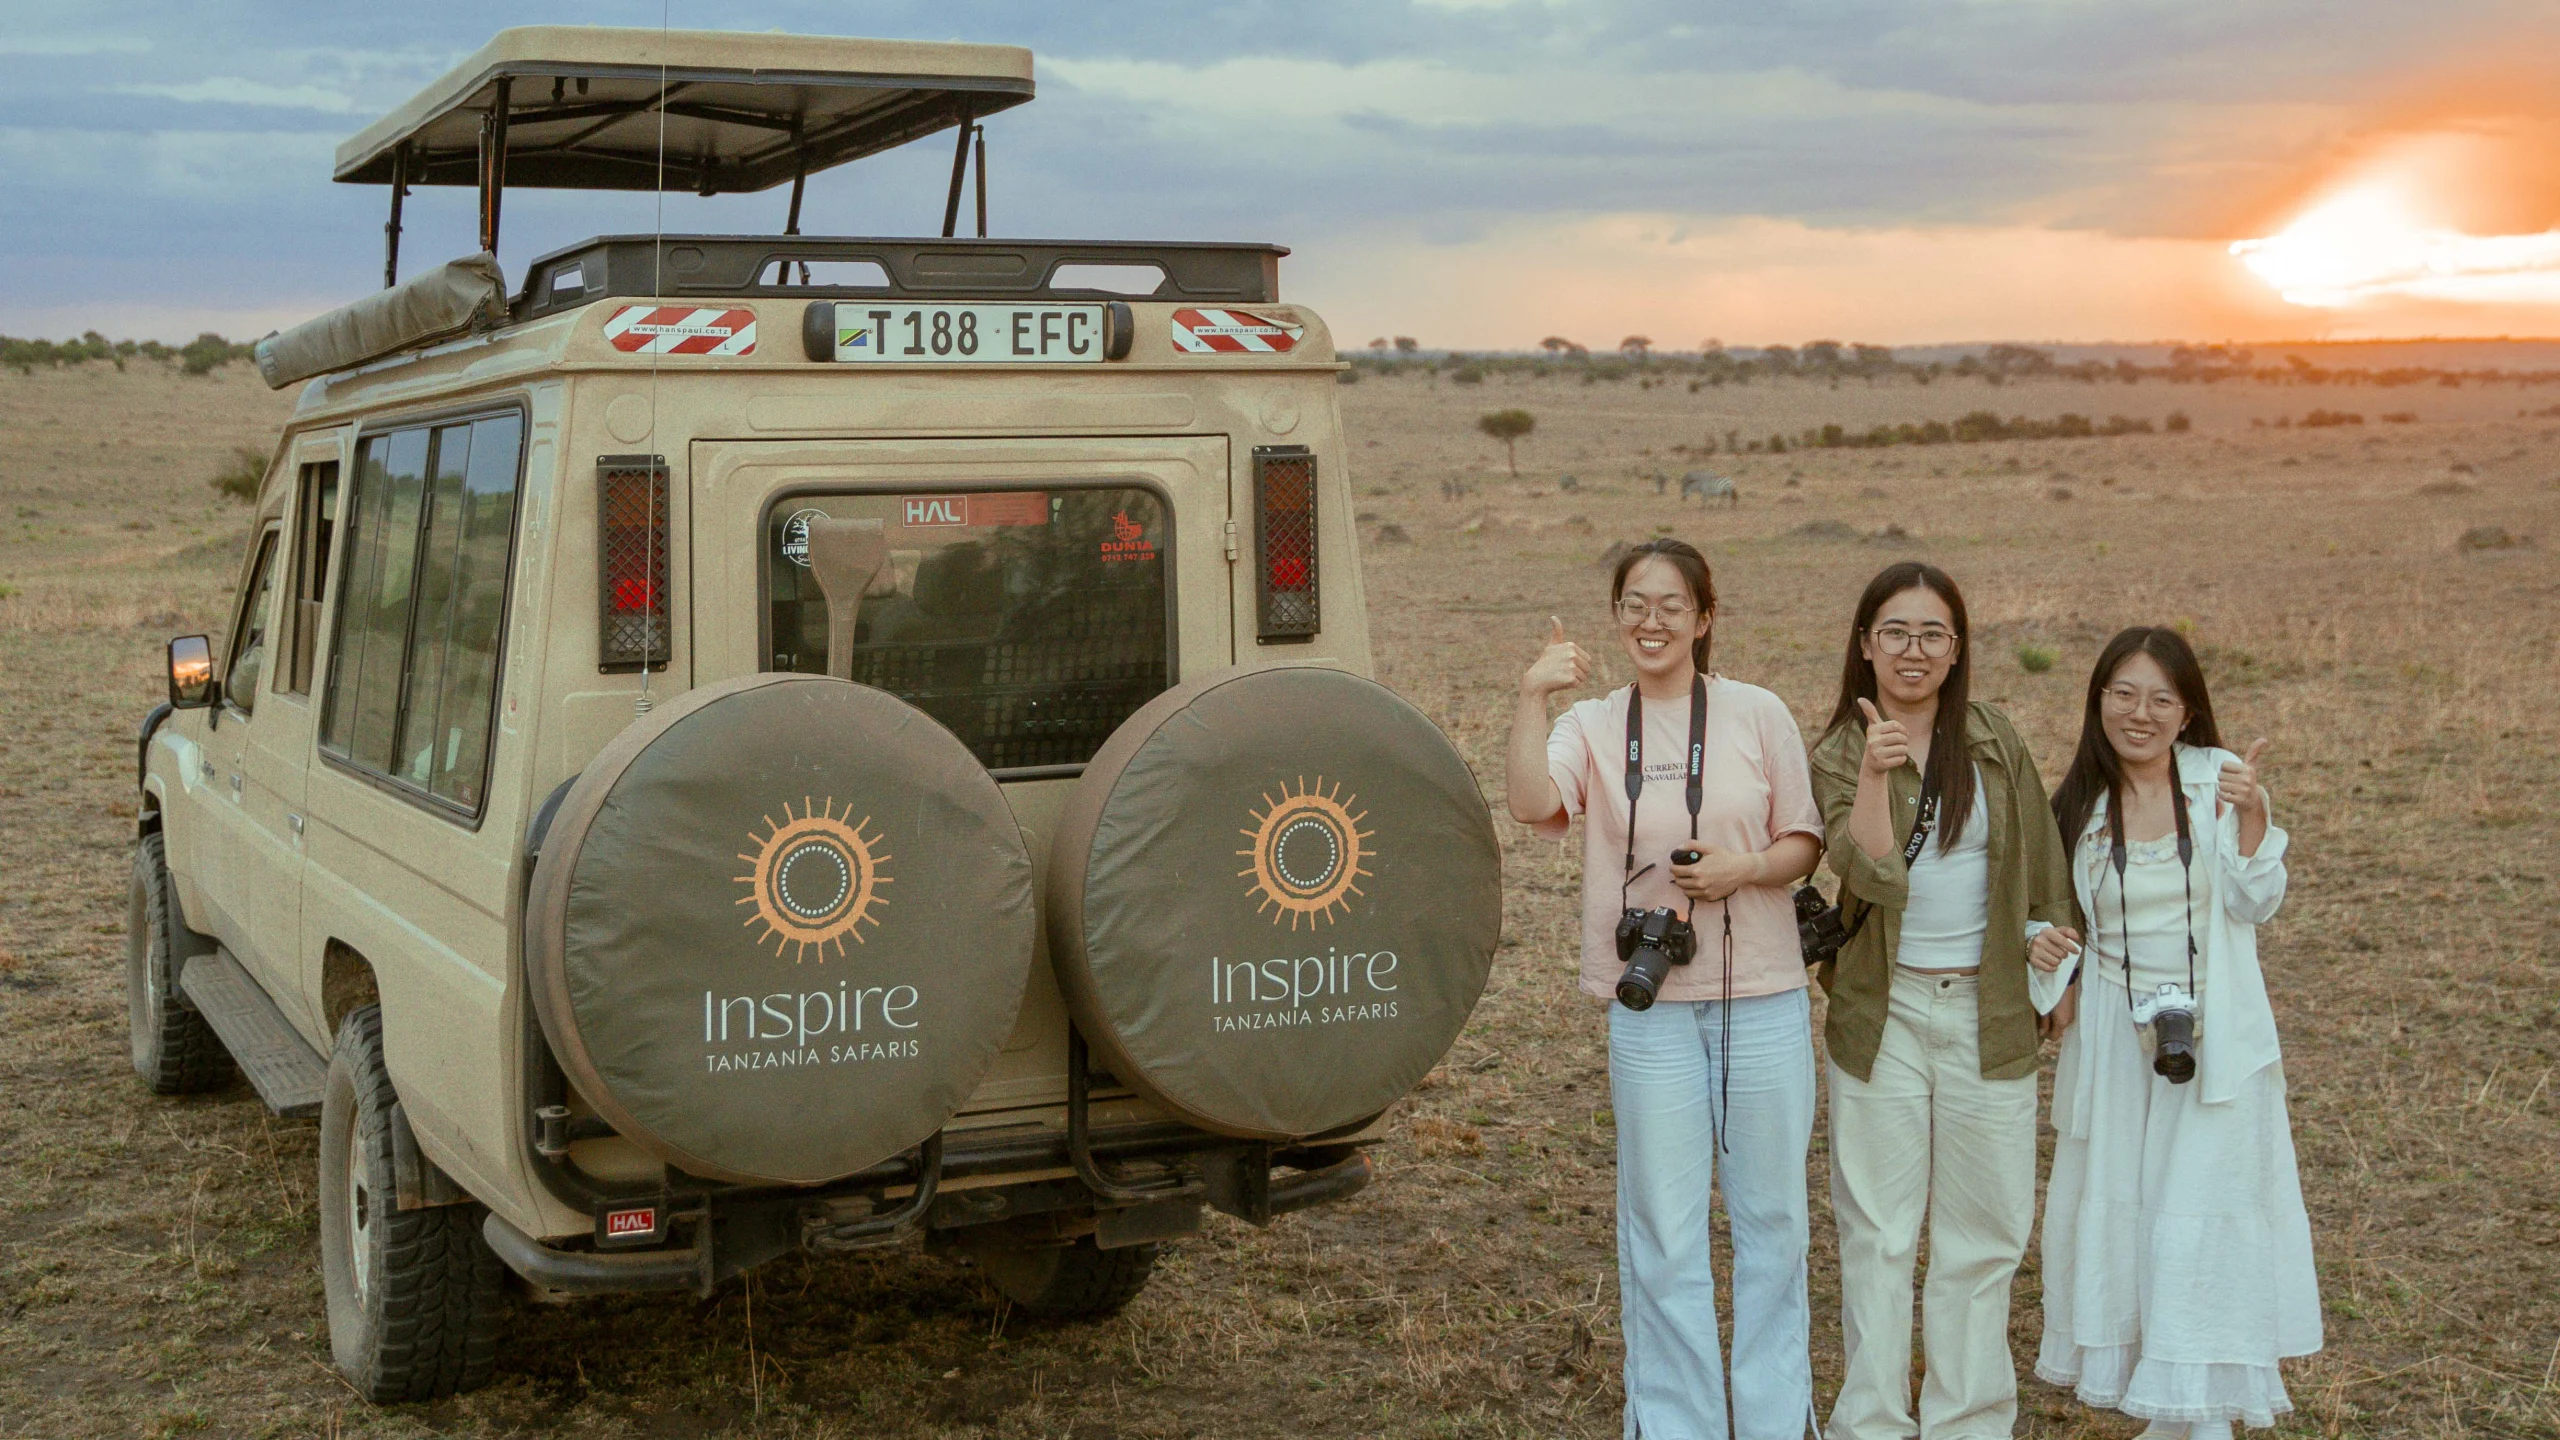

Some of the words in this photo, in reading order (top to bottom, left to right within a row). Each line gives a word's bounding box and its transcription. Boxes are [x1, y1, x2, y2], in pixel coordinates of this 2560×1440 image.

[633, 325, 728, 335] www.hanspaul.co.tz
[868, 310, 892, 355] T
[903, 310, 979, 356] 188
[1012, 311, 1090, 355] EFC
[907, 501, 961, 522] HAL
[1101, 541, 1153, 552] DUNIA
[1630, 740, 1638, 761] EOS
[1692, 743, 1701, 775] Canon
[1904, 832, 1924, 858] RX10
[1213, 947, 1398, 1008] Inspire
[706, 980, 919, 1046] Inspire
[1214, 1009, 1312, 1032] TANZANIA
[1321, 1001, 1398, 1023] SAFARIS
[707, 1048, 820, 1072] TANZANIA
[831, 1040, 919, 1062] SAFARIS
[614, 1214, 648, 1230] HAL
